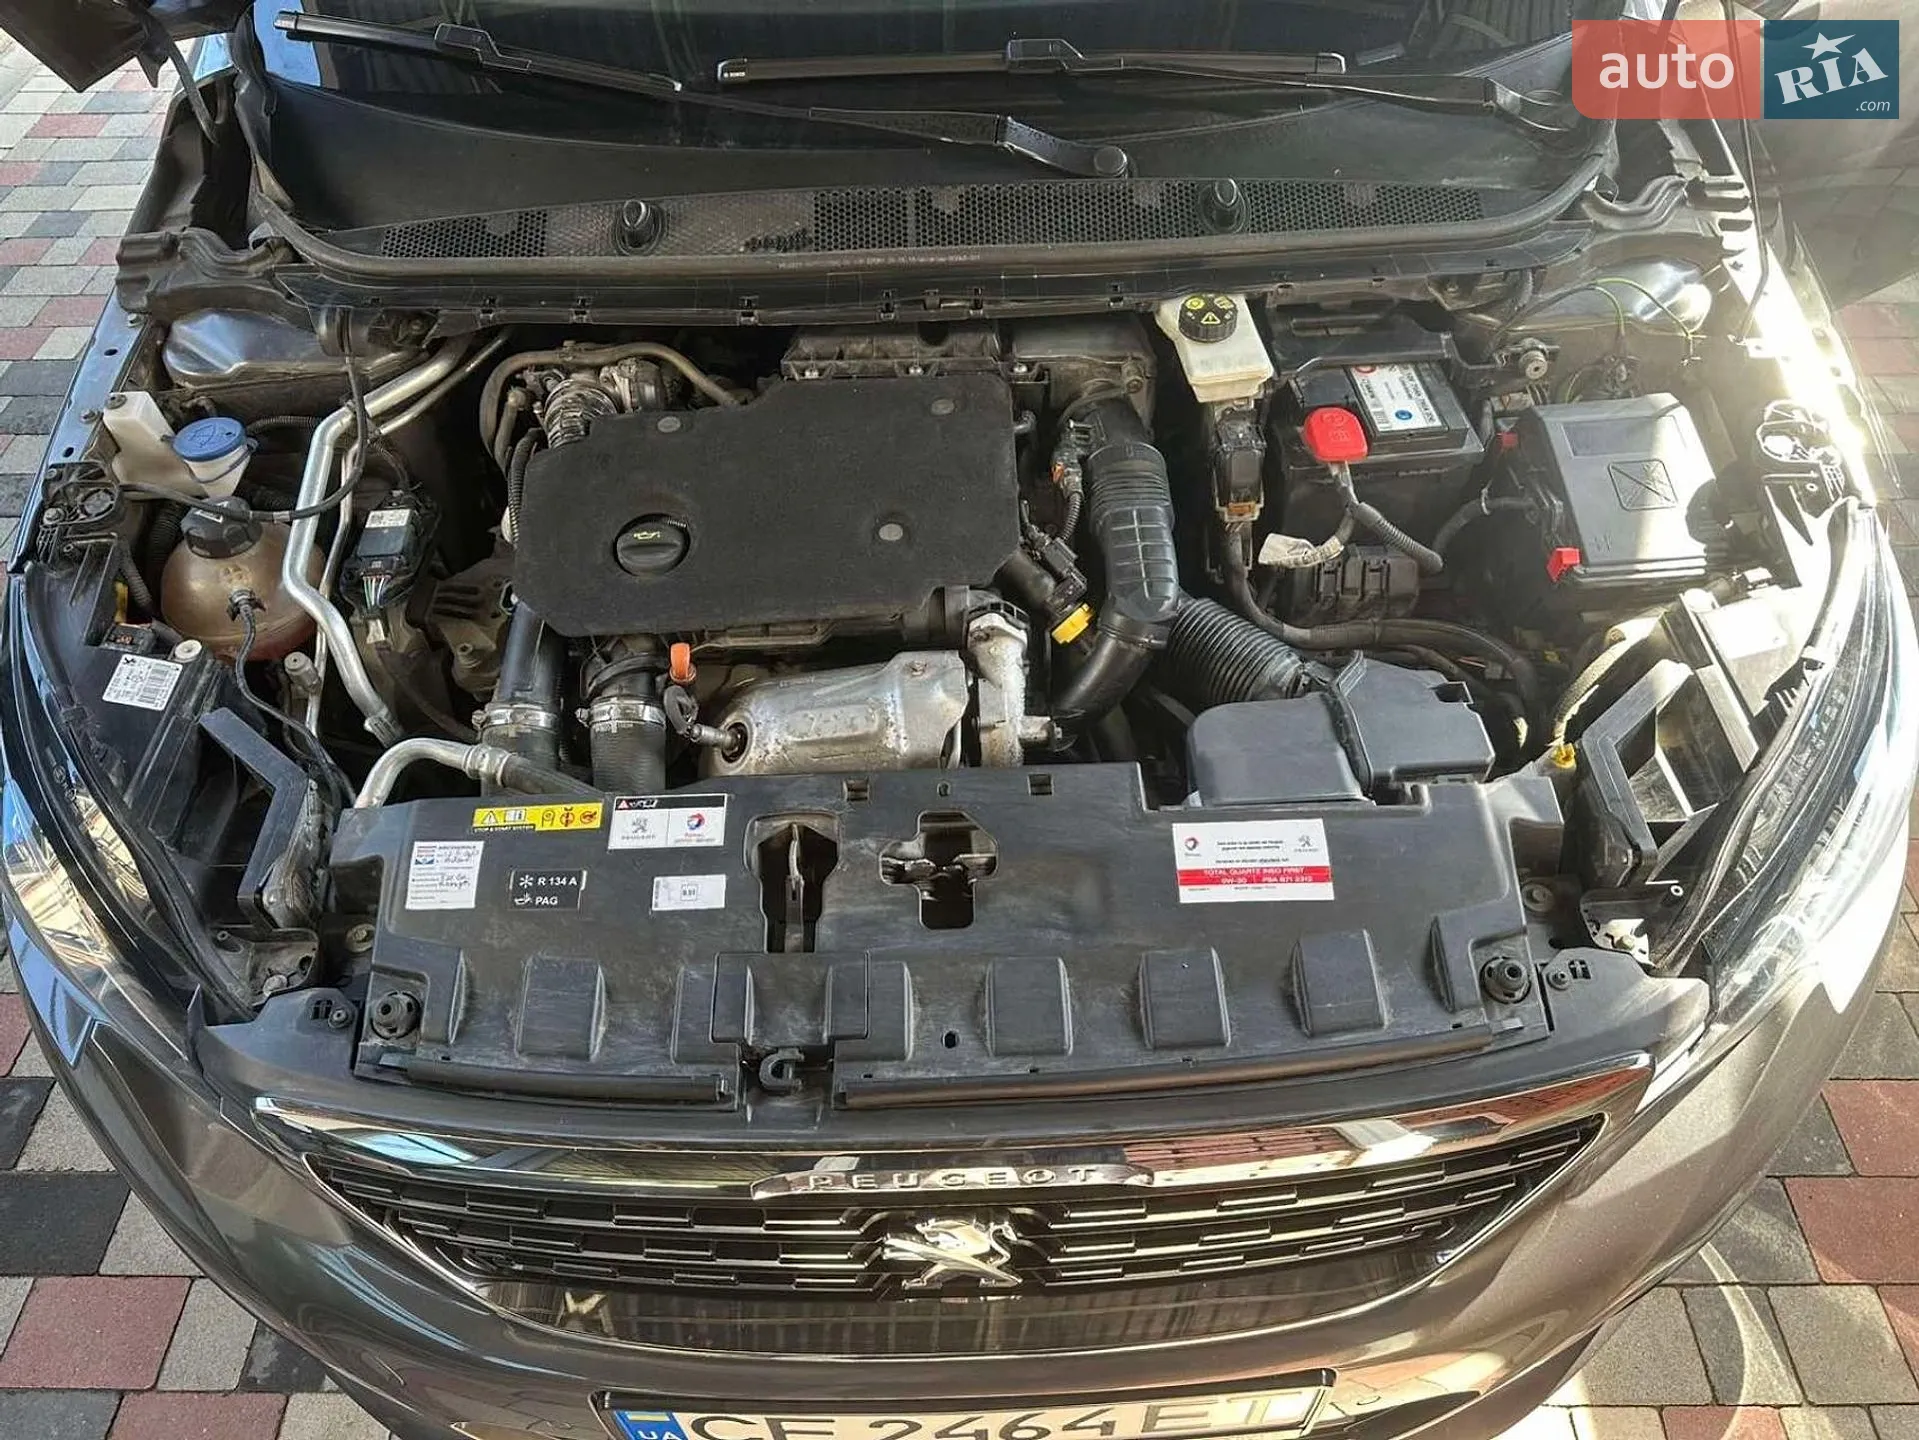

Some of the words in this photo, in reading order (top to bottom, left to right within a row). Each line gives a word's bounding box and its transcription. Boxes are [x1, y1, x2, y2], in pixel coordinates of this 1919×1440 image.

[537, 877, 546, 886] R
[549, 877, 567, 886] 134
[568, 877, 578, 885] A
[535, 896, 558, 906] PAG
[809, 1166, 1098, 1191] PEUGEOT
[869, 1407, 1116, 1440] 2464
[1141, 1391, 1302, 1434] ET
